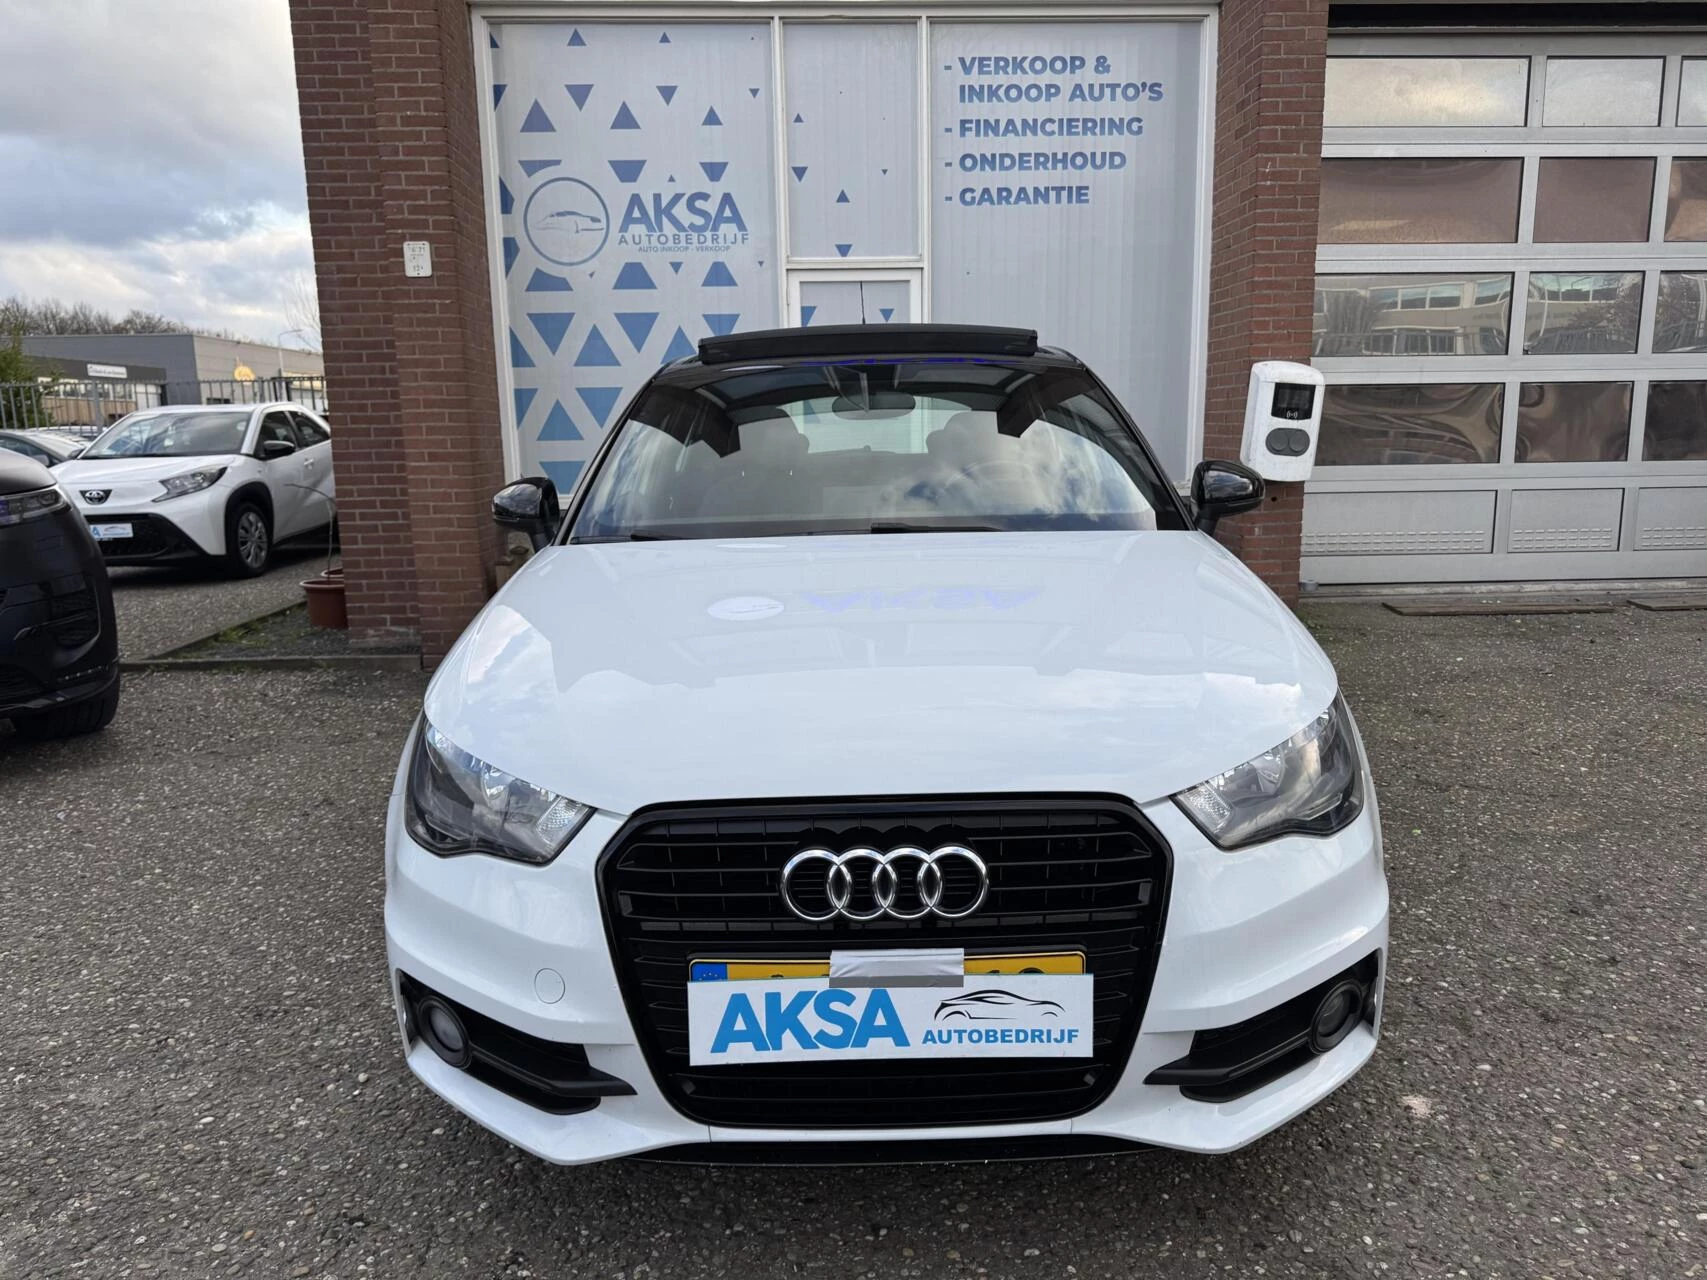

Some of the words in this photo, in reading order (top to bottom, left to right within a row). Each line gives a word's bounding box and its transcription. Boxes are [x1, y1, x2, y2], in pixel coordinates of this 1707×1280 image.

[958, 56, 1086, 75] VERKOOP
[1094, 55, 1111, 75] &
[959, 83, 1061, 103] INKOOP
[1068, 81, 1164, 102] AUTO'S
[959, 117, 1144, 137] FINANCIERING
[959, 151, 1127, 172] ONDERHOUD
[959, 185, 1090, 206] GARANTIE
[618, 192, 748, 233] AKSA
[618, 233, 750, 246] AUTOBEDRIJF
[710, 988, 910, 1054] AKSA
[922, 1028, 1079, 1045] AUTOBEDRIJF
